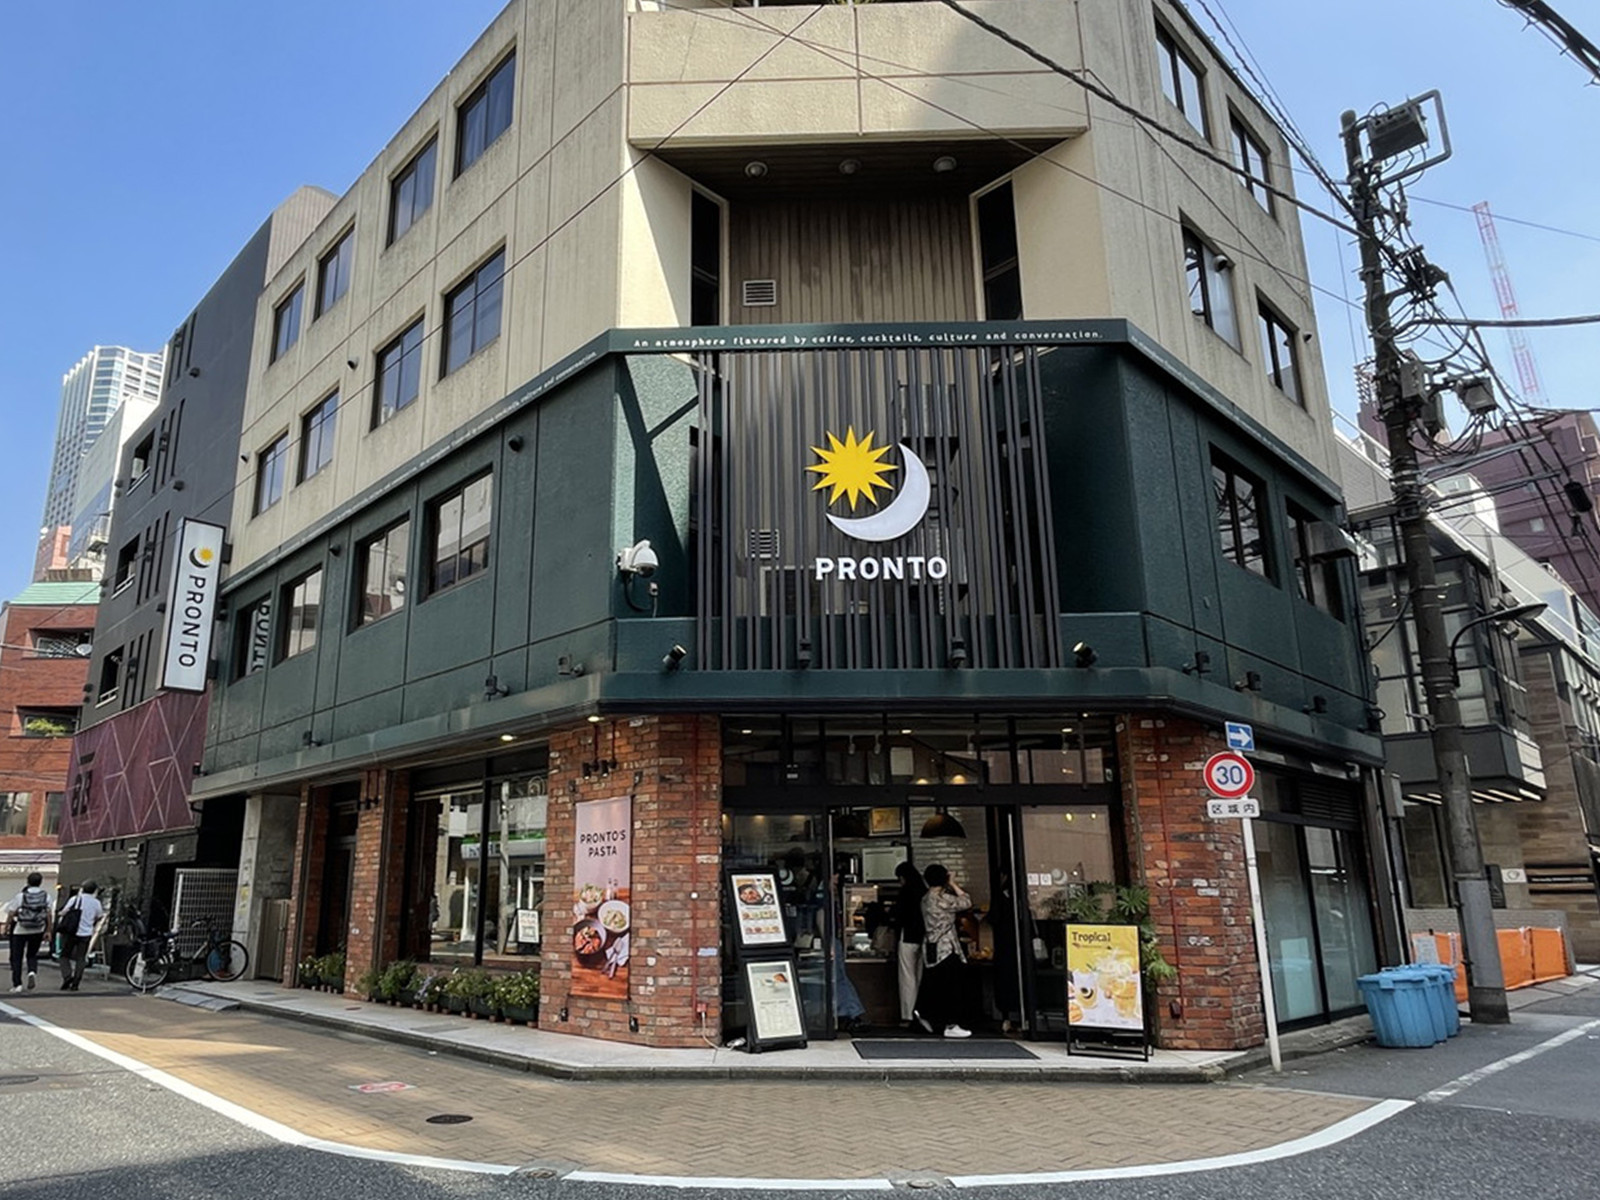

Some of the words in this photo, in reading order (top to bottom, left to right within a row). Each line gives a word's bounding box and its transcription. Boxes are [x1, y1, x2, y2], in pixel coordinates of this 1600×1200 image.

[633, 339, 649, 347] An
[655, 337, 727, 348] atmosphere
[733, 335, 787, 346] flavored
[794, 335, 807, 345] by
[812, 335, 855, 344] coffee,
[860, 333, 922, 343] cocktails,
[929, 332, 978, 342] culture
[986, 332, 1007, 340] and
[1014, 330, 1103, 340] conversation.
[815, 556, 947, 580] PRONTO
[179, 575, 206, 668] PRONTO
[1216, 765, 1243, 786] 30
[588, 846, 617, 857] PASTA
[1071, 931, 1111, 944] Tropical
